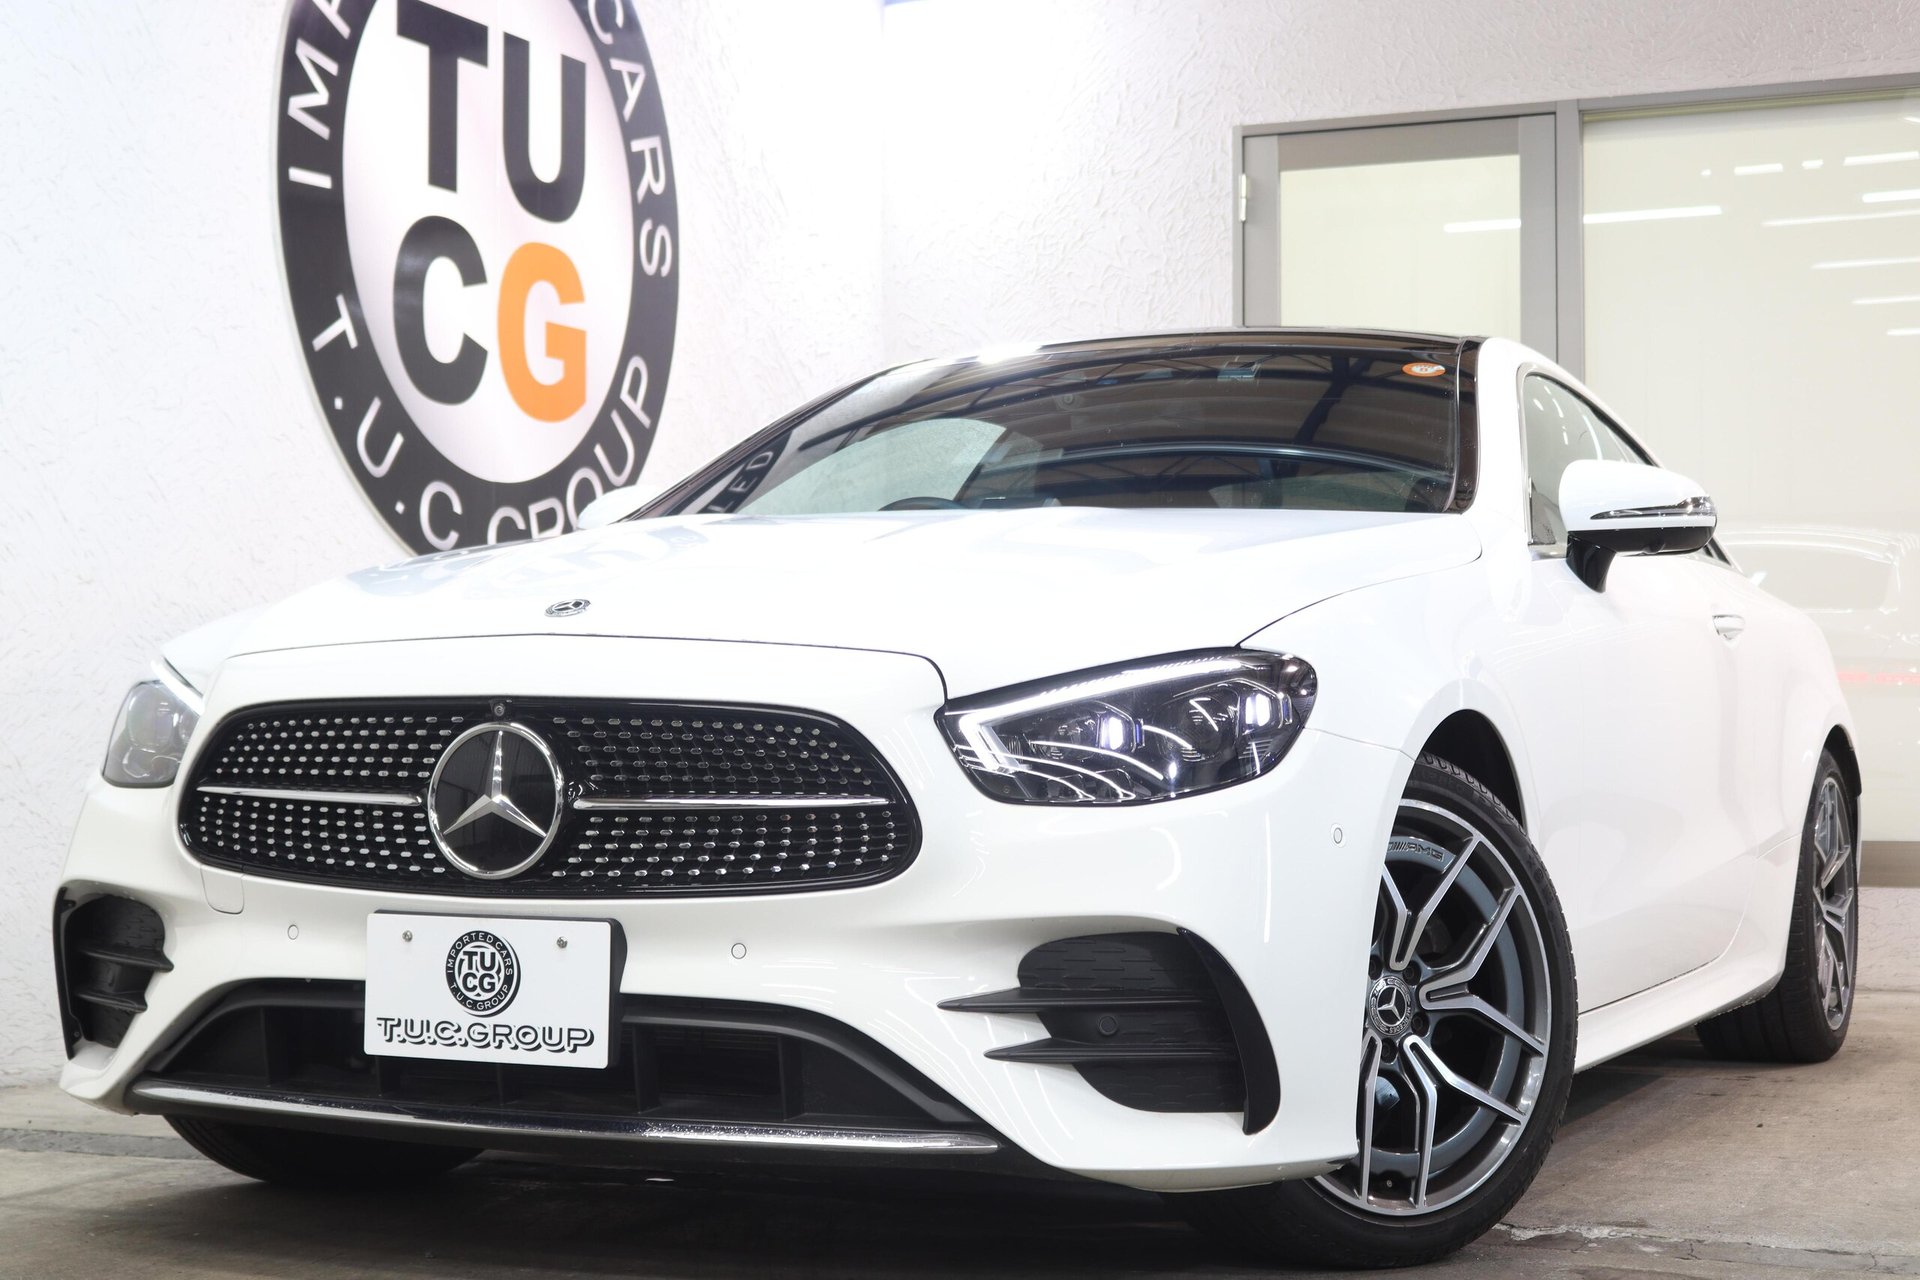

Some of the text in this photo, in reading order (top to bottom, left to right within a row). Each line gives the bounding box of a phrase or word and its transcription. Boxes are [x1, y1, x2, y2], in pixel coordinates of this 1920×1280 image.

[397, 0, 587, 223] TU
[588, 0, 673, 278] CARS
[393, 215, 587, 423] CG
[446, 932, 513, 976] IMPORTED CARS
[462, 950, 496, 971] TU
[461, 972, 496, 993] CG
[376, 1017, 595, 1053] T.U.C.GROUP
